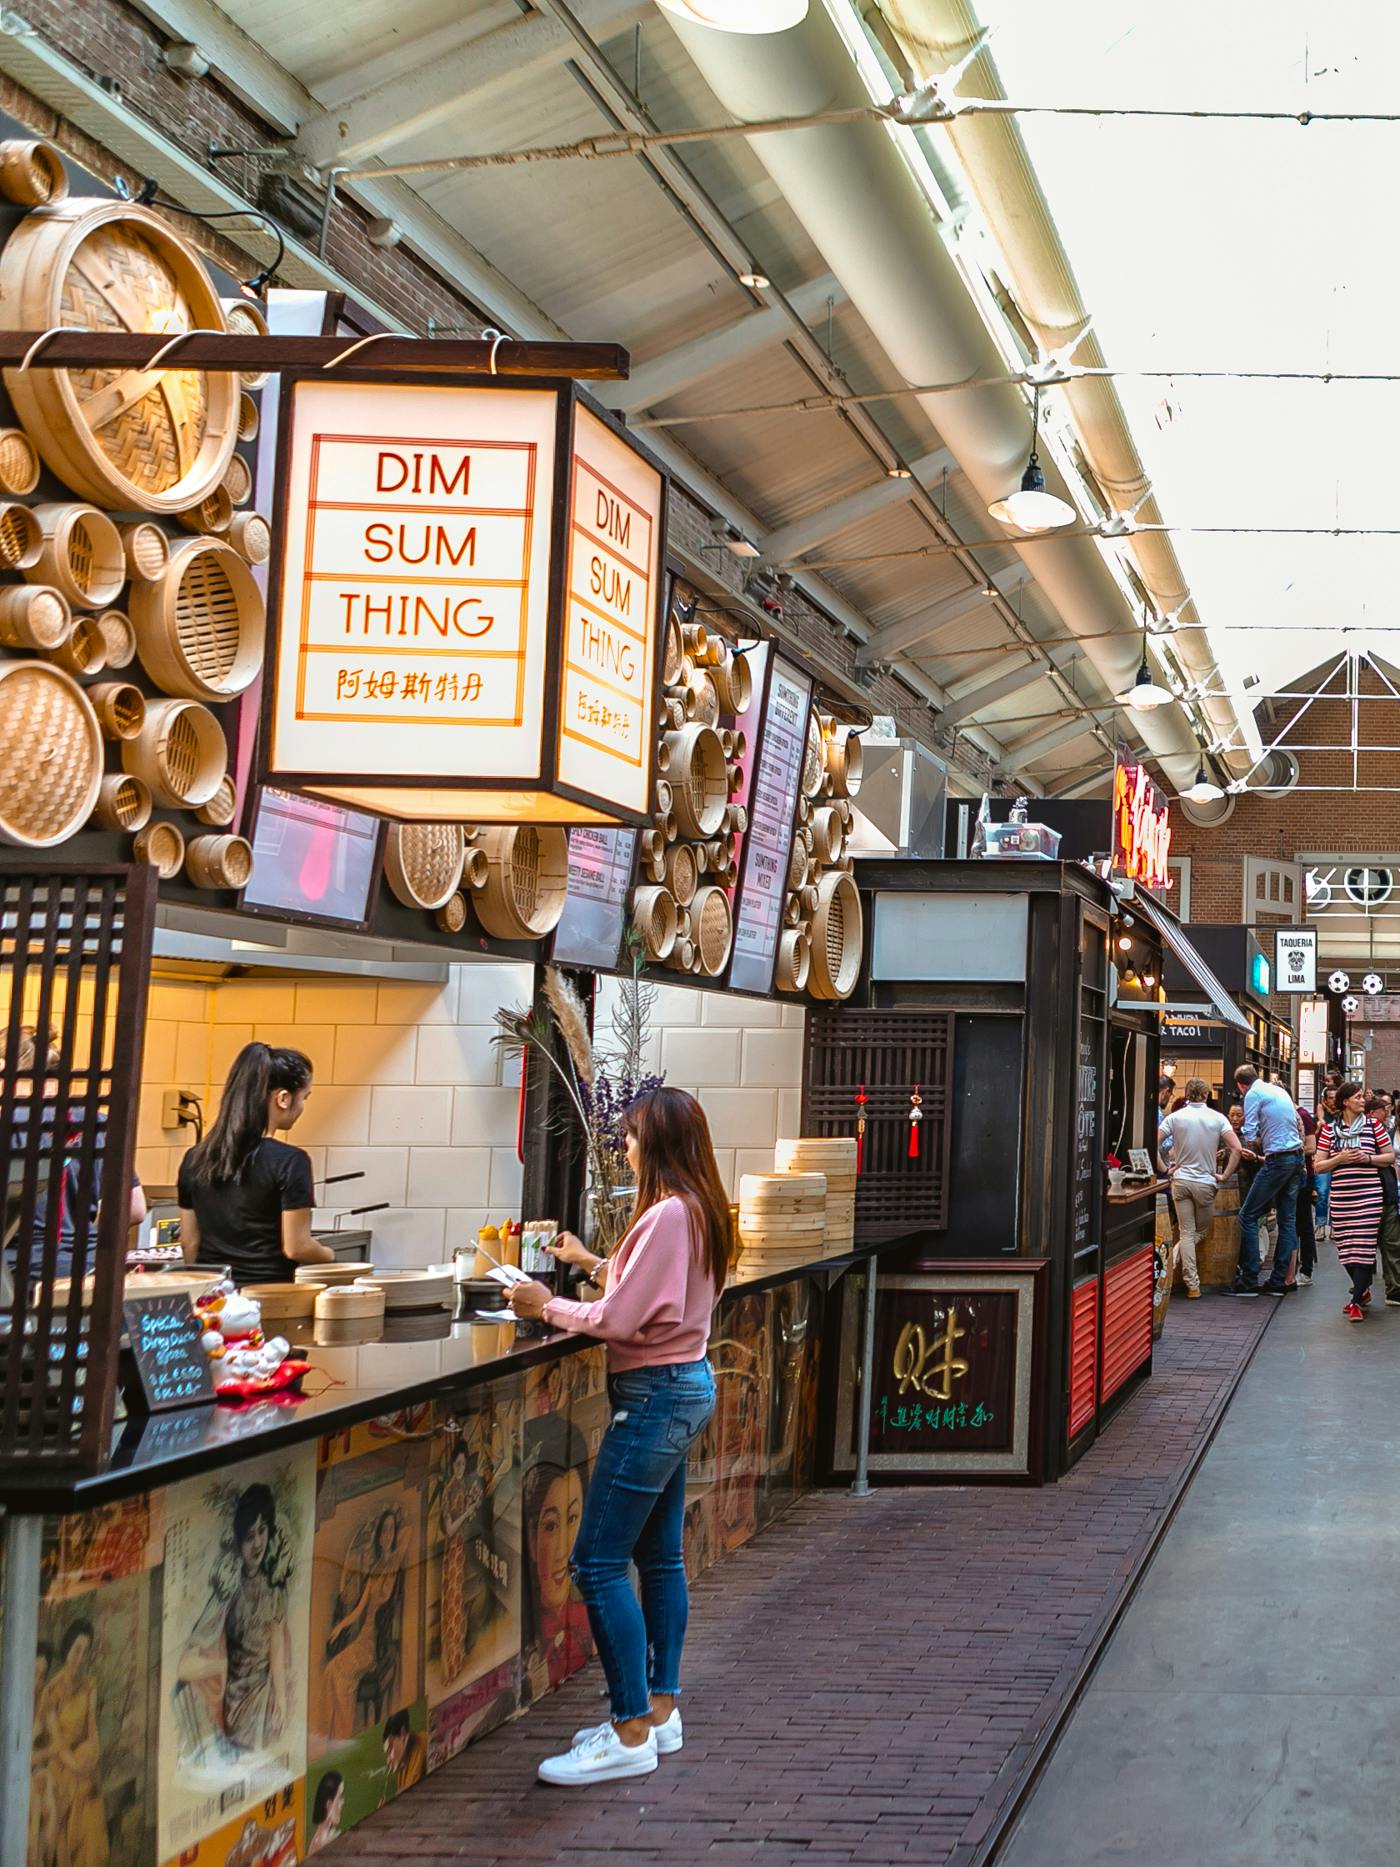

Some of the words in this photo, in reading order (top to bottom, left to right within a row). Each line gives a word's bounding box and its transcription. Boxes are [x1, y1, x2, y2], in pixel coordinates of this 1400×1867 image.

[377, 452, 471, 495] DIM
[597, 489, 631, 550] DIM
[364, 523, 476, 567] SUM
[590, 556, 631, 616] SUM
[339, 593, 494, 638] THING
[581, 618, 635, 681] THING
[336, 669, 484, 704] 阿姆斯特丹
[1280, 938, 1313, 948] TAQUERIA
[1288, 974, 1306, 984] LIMA
[1170, 1026, 1201, 1037] TACO!
